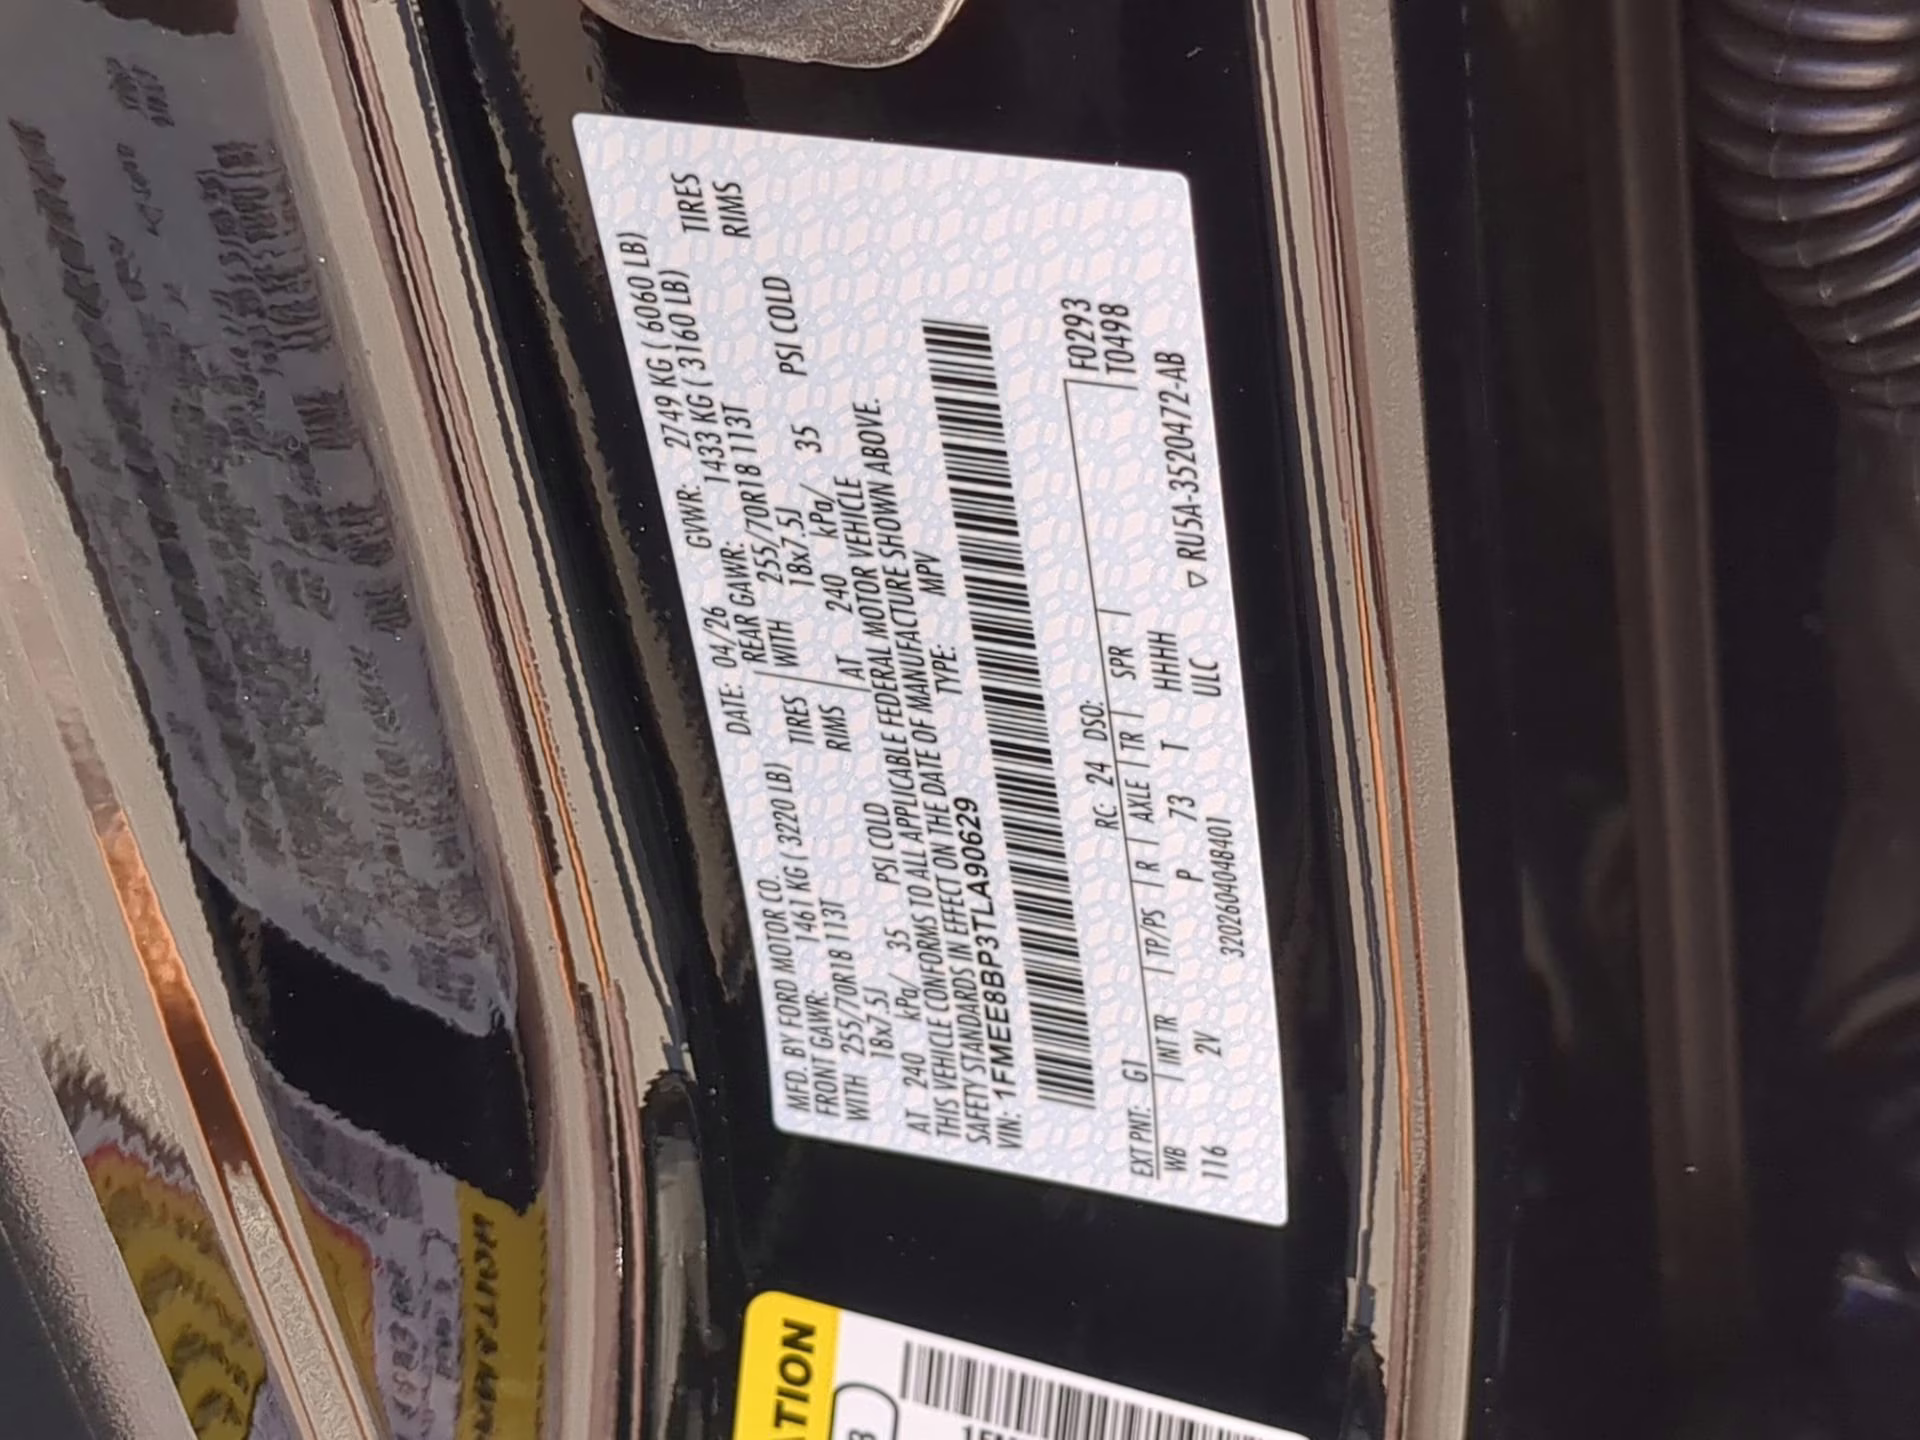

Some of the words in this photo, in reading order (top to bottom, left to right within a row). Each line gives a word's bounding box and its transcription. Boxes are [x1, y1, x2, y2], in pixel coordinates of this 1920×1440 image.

[669, 171, 711, 234] TIRES
[710, 180, 752, 240] RIMS
[626, 274, 666, 334] 6060
[760, 274, 800, 335] COLD
[666, 312, 708, 372] 3160
[773, 340, 809, 378] PSI
[1059, 296, 1101, 373] F0293
[1096, 301, 1138, 376] T0498
[644, 356, 678, 389] KG
[653, 393, 693, 451] 2749
[684, 393, 719, 425] KG
[719, 401, 758, 454] 113T
[692, 430, 732, 484] 1433
[789, 422, 824, 455] 35
[850, 397, 894, 478] ABOVE.
[1152, 350, 1208, 563] RU5A-3520472-AB
[674, 483, 714, 550] GVWR:
[733, 462, 785, 586] 255/70R18
[832, 475, 875, 559] VEHICLE
[866, 480, 908, 561] SHOWN
[773, 505, 816, 588] 18x7.5J
[718, 540, 757, 609] GAWR:
[819, 572, 854, 615] 240
[911, 549, 948, 598] MPV
[849, 564, 890, 641] MOTOR
[699, 605, 739, 670] 04/26
[732, 612, 769, 665] REAR
[765, 617, 801, 668] WITH
[881, 565, 935, 715] MANUFACTURE
[1145, 629, 1184, 694] HHHH
[834, 653, 866, 682] AT
[864, 646, 906, 729] FEDERAL
[928, 643, 964, 696] TYPE:
[1106, 644, 1138, 682] SPR
[1187, 656, 1223, 699] ULC
[717, 682, 753, 737] DATE:
[779, 694, 816, 746] TIRES
[816, 703, 853, 754] RIMS
[908, 717, 939, 746] OF
[1078, 698, 1109, 743] DSO:
[1117, 730, 1146, 752] TR
[1159, 738, 1190, 752] T
[879, 731, 925, 845] APPLICABLE
[913, 748, 948, 798] DATE
[1082, 759, 1116, 789] 24
[769, 797, 804, 848] 3220
[861, 801, 895, 852] COLD
[922, 801, 954, 837] THE
[1091, 802, 1121, 832] RC:
[1123, 778, 1156, 825] AXLE
[1165, 793, 1198, 823] 73
[781, 864, 812, 893] KG
[870, 855, 902, 887] PSI
[900, 850, 930, 882] ALL
[930, 841, 959, 871] ON
[1133, 859, 1161, 874] R
[1174, 867, 1205, 884] P
[755, 875, 784, 904] CO.
[905, 883, 935, 908] TO
[934, 874, 970, 937] EFFECT
[1204, 815, 1246, 959] 3202604048401
[761, 907, 796, 975] MOTOR
[788, 898, 821, 943] 1461
[818, 896, 851, 942] 113T
[882, 926, 913, 954] 35
[1139, 907, 1172, 958] TP/PS
[909, 912, 950, 1013] CONFORMS
[947, 941, 973, 962] IN
[951, 795, 1018, 1101] 1FMEE8BP3TLA90629
[773, 978, 802, 1029] FORD
[804, 989, 835, 1051] GAWR:
[826, 947, 866, 1057] 255/70R18
[862, 986, 895, 1060] 18x7.5J
[949, 966, 987, 1074] STANDARDS
[1152, 1013, 1178, 1033] TR
[780, 1034, 807, 1059] BY
[926, 1017, 958, 1091] VEHICLE
[1154, 1035, 1182, 1067] INT
[1192, 1029, 1223, 1058] 2V
[783, 1066, 810, 1113] MFD.
[810, 1055, 840, 1118] FRONT
[899, 1051, 929, 1090] 240
[1120, 1058, 1150, 1085] G1
[843, 1073, 871, 1122] WITH
[904, 1108, 931, 1136] AT
[933, 1097, 962, 1139] THIS
[962, 1078, 992, 1146] SAFETY
[997, 1110, 1023, 1150] VIN:
[1126, 1105, 1152, 1143] PNT:
[1128, 1144, 1155, 1179] EXT
[1162, 1145, 1188, 1173] WB
[1200, 1144, 1229, 1181] 116
